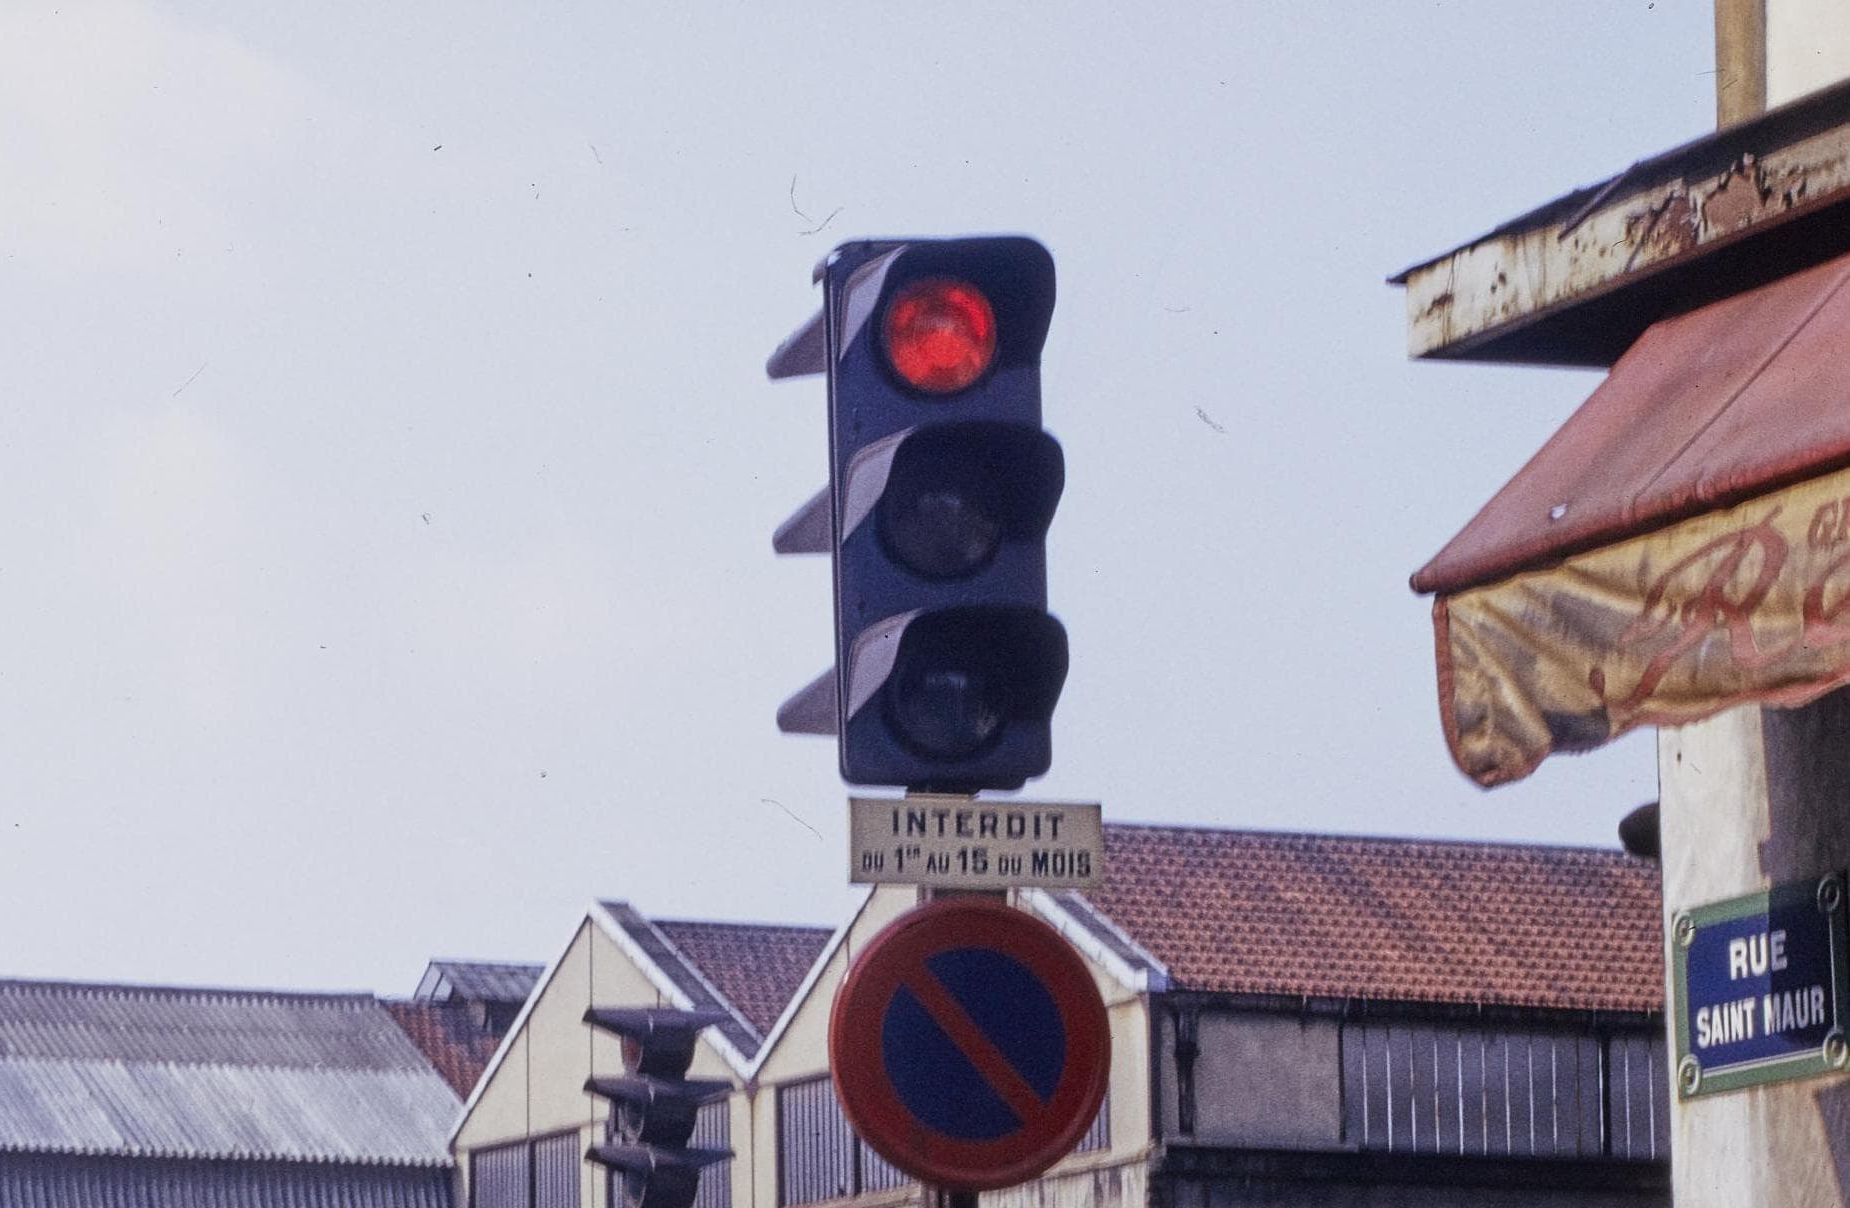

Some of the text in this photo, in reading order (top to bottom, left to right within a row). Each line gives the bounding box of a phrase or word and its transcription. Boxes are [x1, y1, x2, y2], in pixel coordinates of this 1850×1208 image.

[891, 808, 1064, 840] INTERDIT
[862, 851, 884, 872] DU
[926, 853, 950, 875] AU
[957, 847, 988, 874] 15
[998, 855, 1022, 876] DU
[1032, 850, 1091, 878] MOIS
[1729, 929, 1788, 981] RUE
[1696, 984, 1825, 1049] SAINT MAUR
